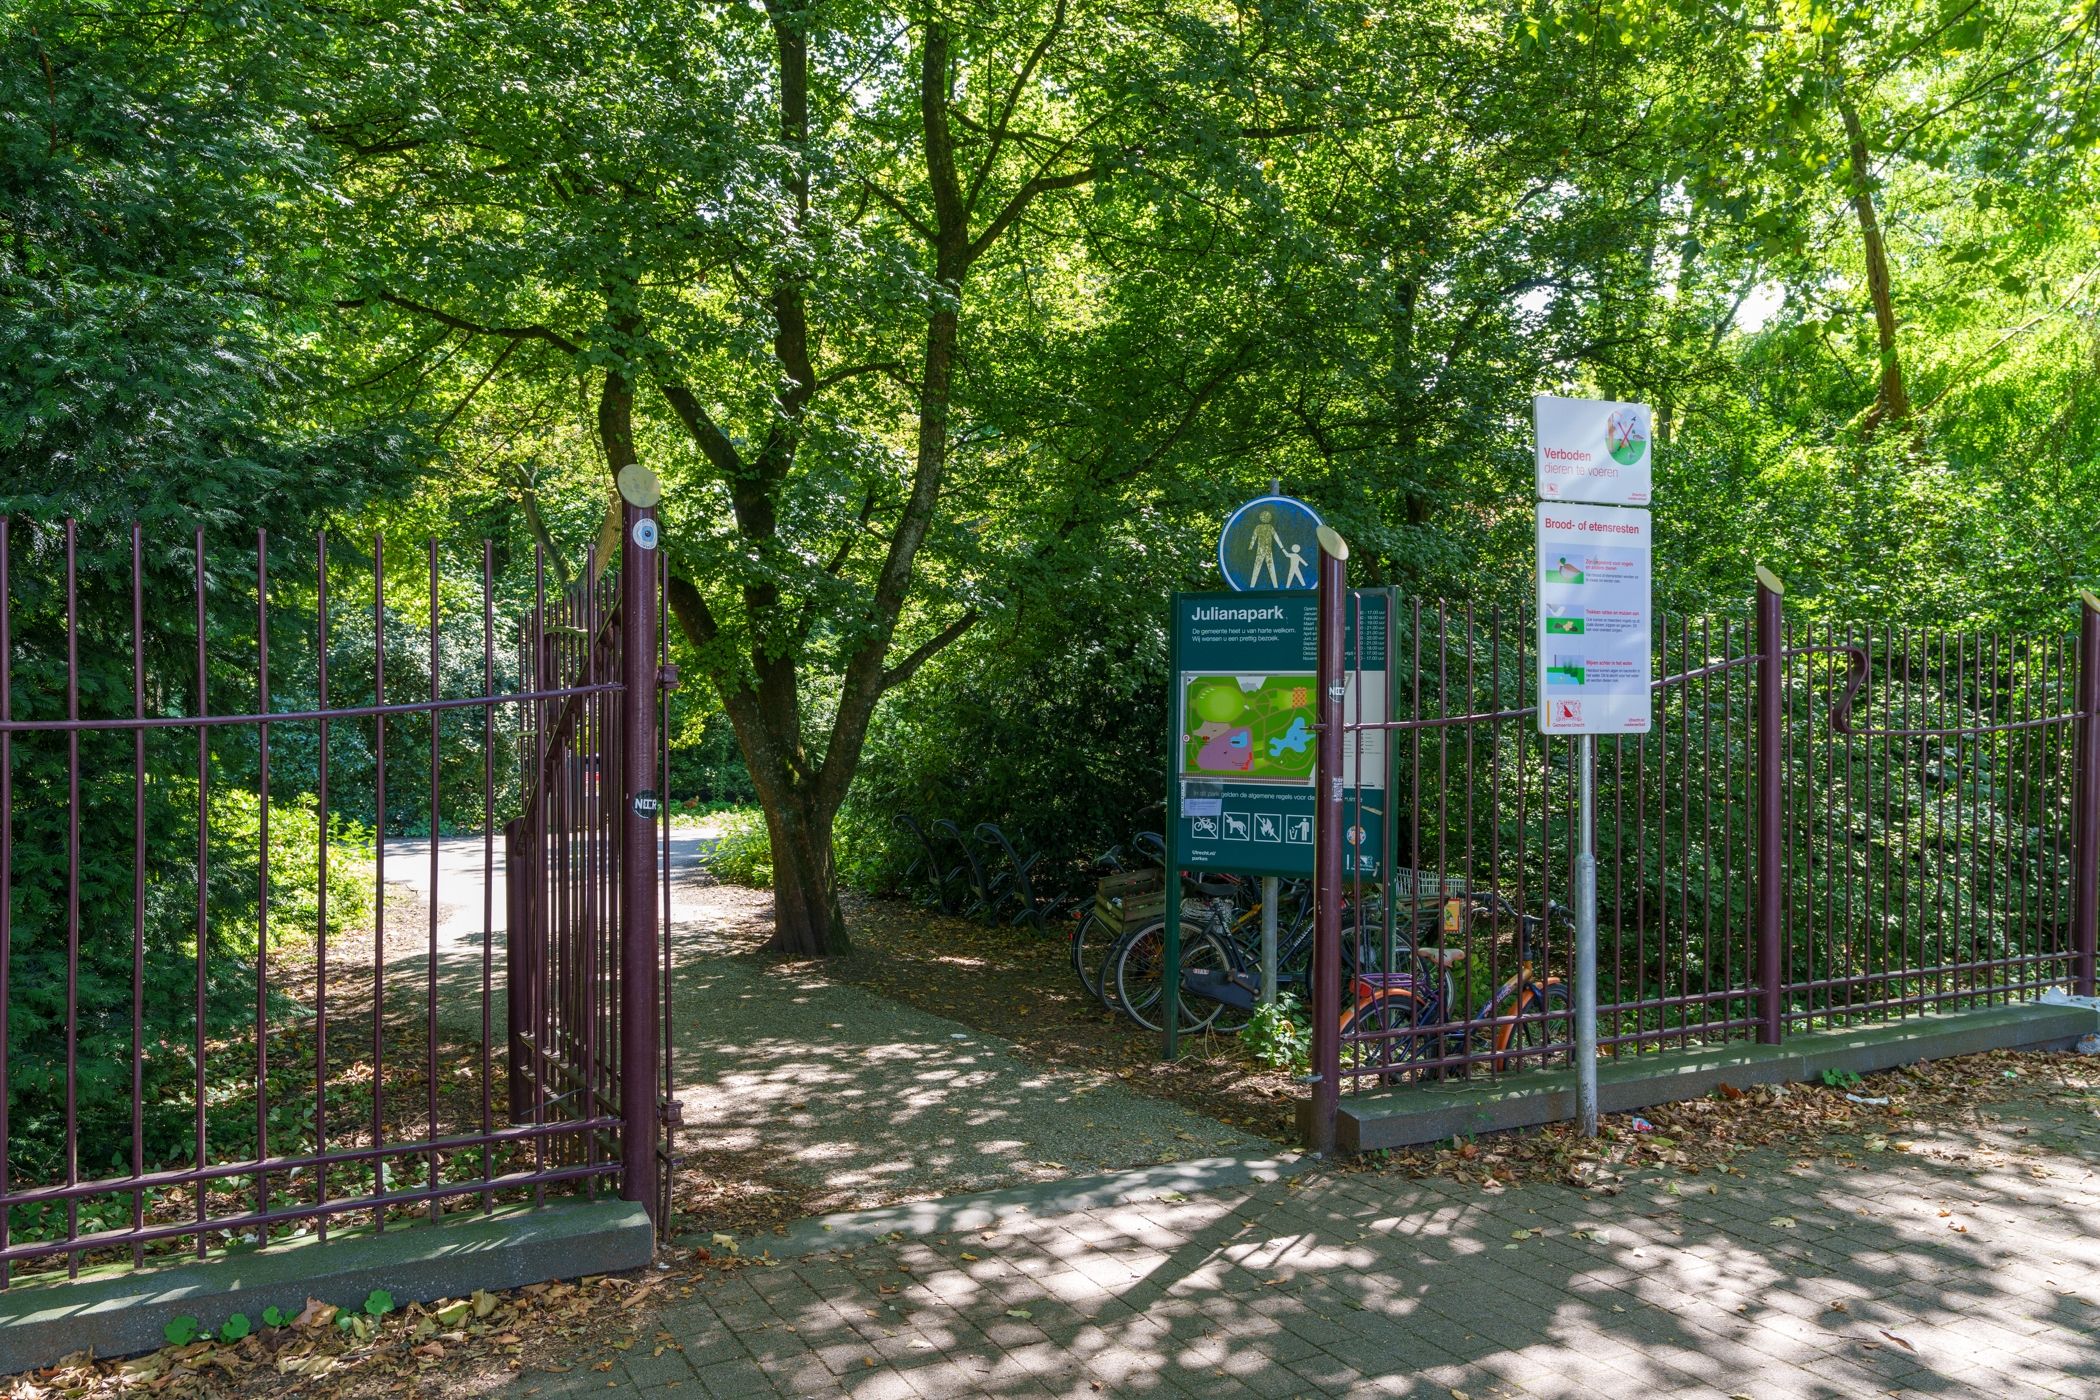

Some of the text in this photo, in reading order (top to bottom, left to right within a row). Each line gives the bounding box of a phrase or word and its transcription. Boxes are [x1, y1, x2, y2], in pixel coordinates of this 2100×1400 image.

[1544, 447, 1591, 461] Verboden
[1544, 463, 1619, 478] dieren te voeren
[1545, 518, 1640, 534] Brood- of etensresten
[1191, 605, 1284, 623] Julianapark
[1201, 628, 1228, 636] gemeente
[1228, 627, 1241, 635] heet
[1192, 635, 1201, 643] Wij
[1239, 635, 1257, 643] prettig
[1220, 791, 1239, 799] gelden
[1248, 792, 1275, 800] algemene
[1275, 793, 1293, 801] regels
